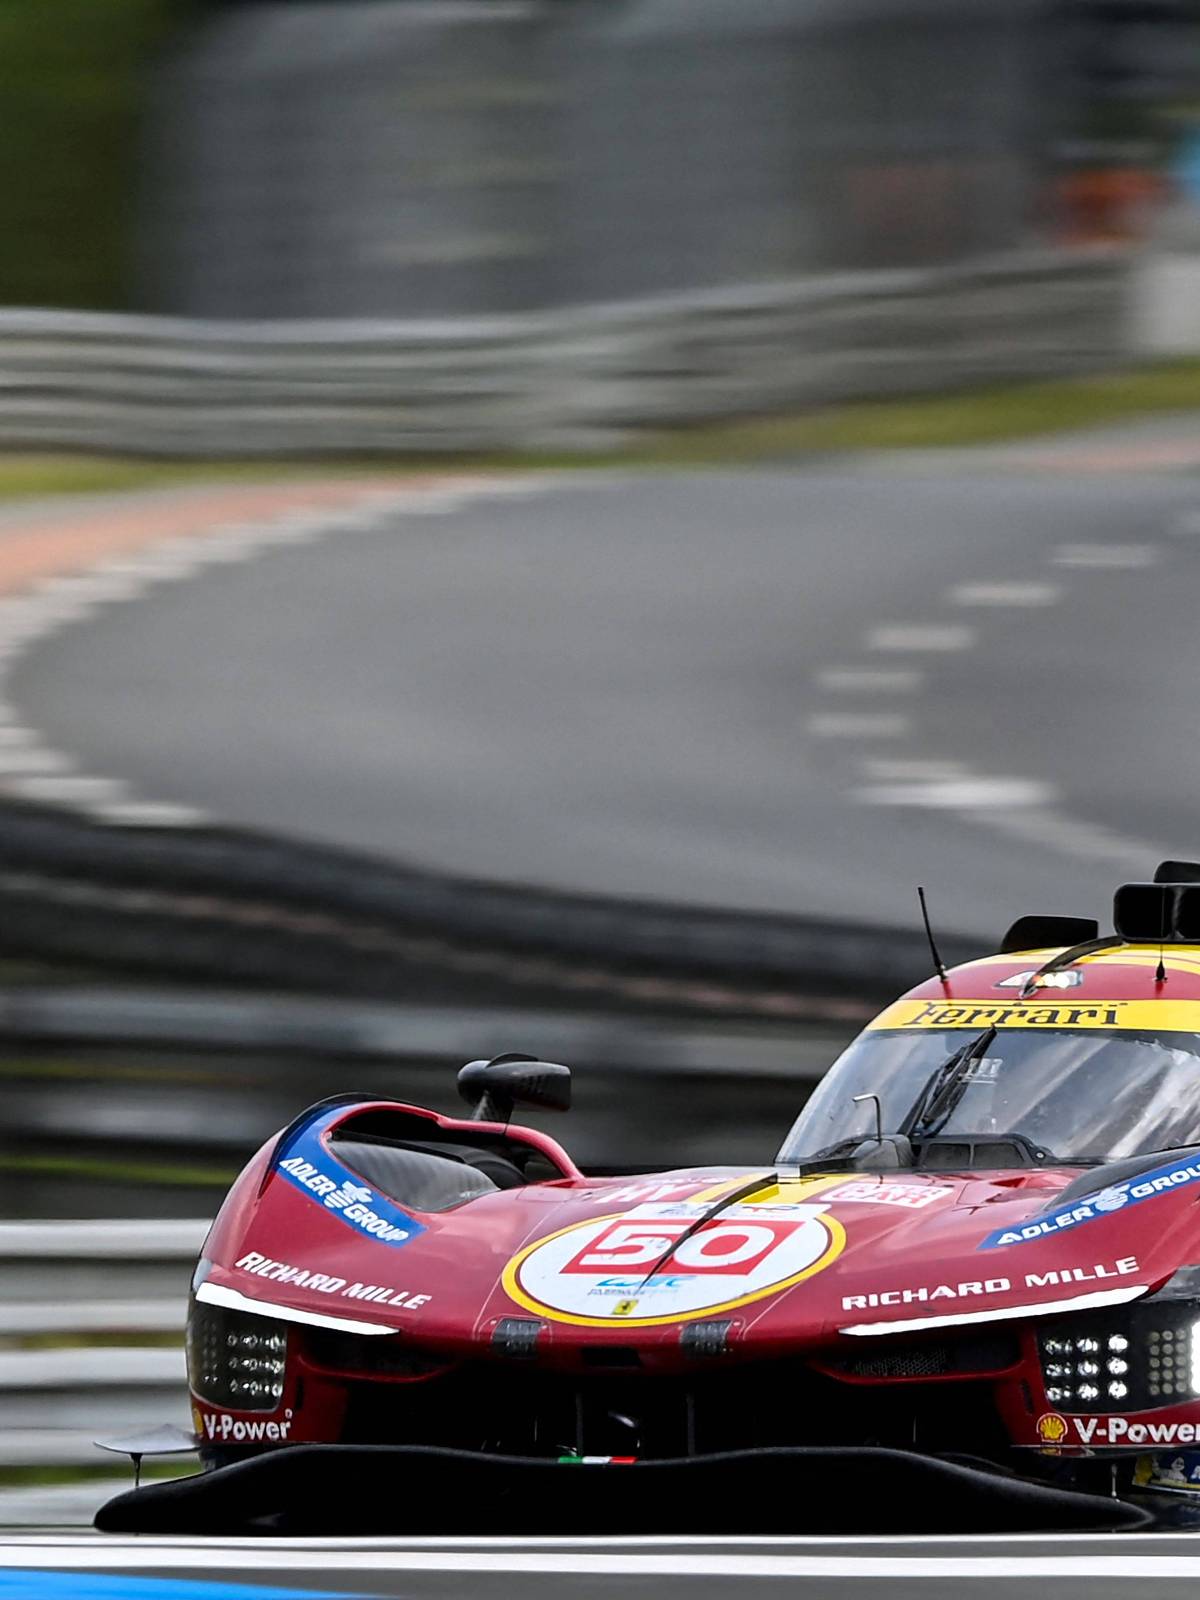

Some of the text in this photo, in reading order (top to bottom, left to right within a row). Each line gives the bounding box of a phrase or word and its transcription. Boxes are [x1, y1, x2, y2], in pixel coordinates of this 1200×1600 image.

[902, 1001, 1129, 1026] Ferrari
[279, 1156, 410, 1242] ADLER GROUP
[579, 1223, 777, 1268] 50
[997, 1207, 1095, 1246] ADLER
[235, 1251, 432, 1311] RICHARD MILLE
[842, 1255, 1141, 1311] RICHARD MILLE
[203, 1413, 292, 1441] V-Power
